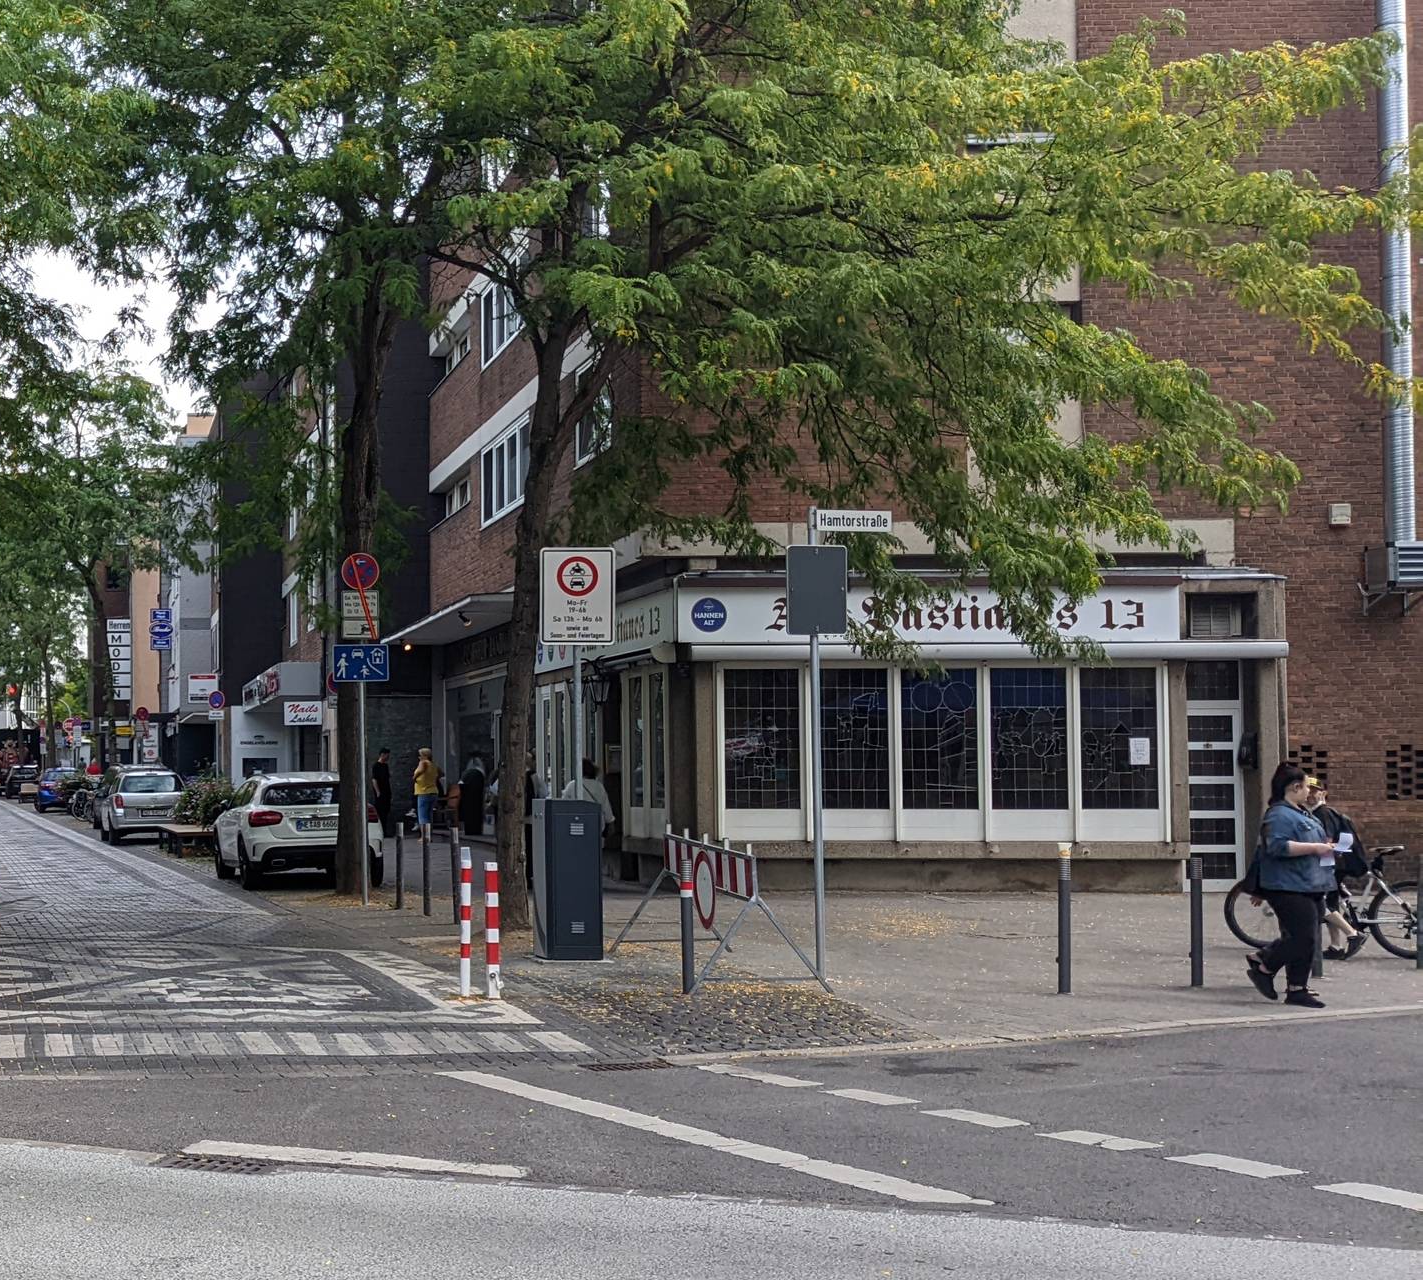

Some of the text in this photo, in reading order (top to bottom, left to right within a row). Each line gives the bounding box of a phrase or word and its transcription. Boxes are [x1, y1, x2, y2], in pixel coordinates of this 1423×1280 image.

[820, 512, 888, 528] Hamtorstraße
[1100, 599, 1145, 630] 13
[287, 703, 318, 713] Nails
[289, 714, 317, 723] Lashes
